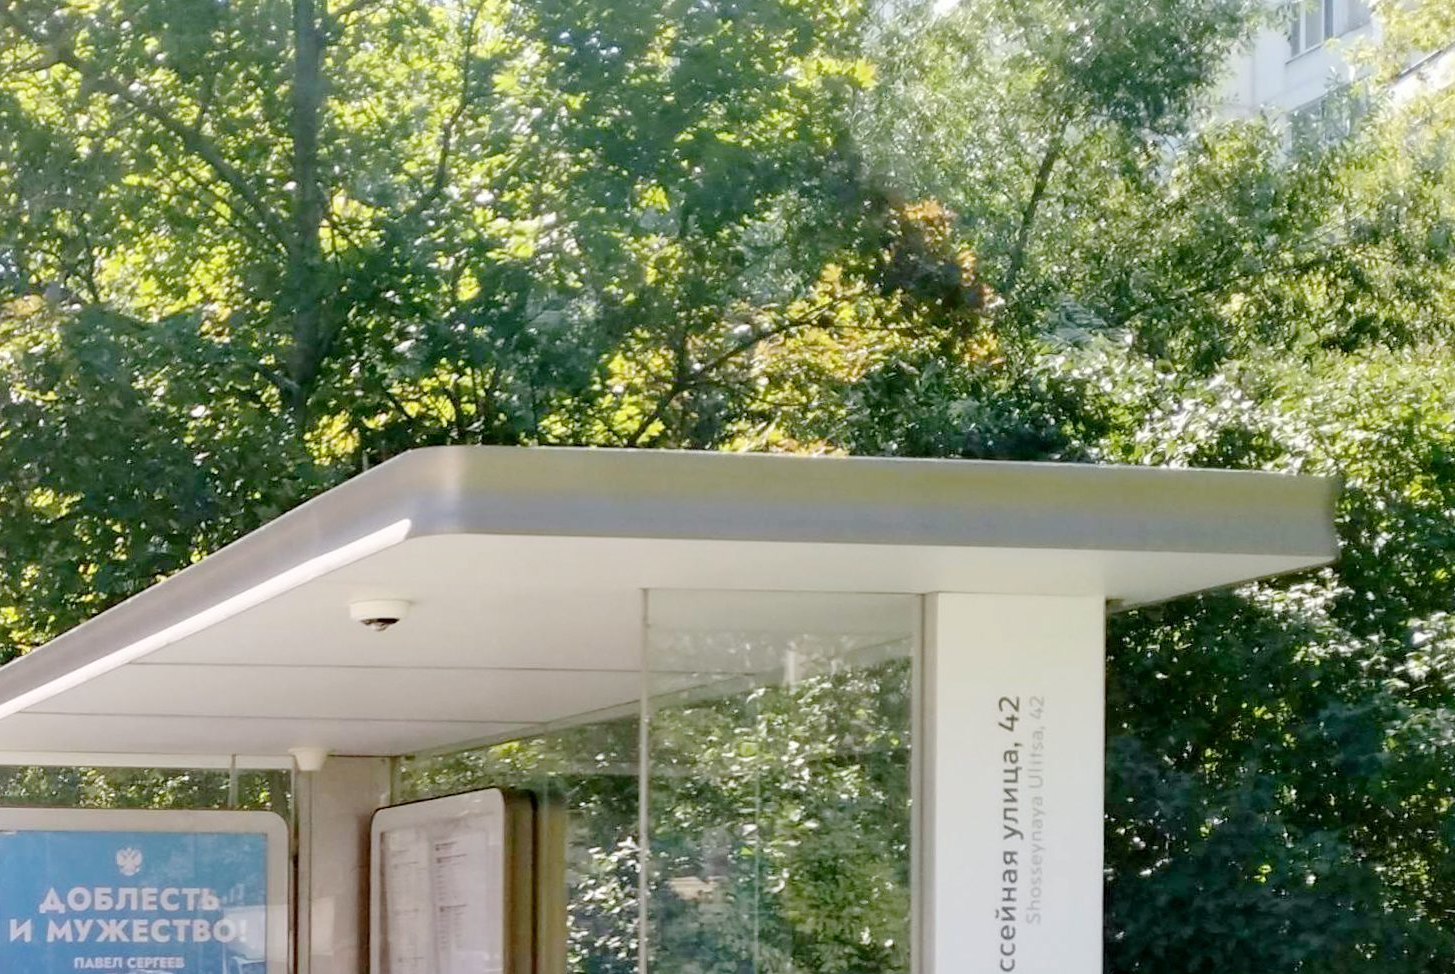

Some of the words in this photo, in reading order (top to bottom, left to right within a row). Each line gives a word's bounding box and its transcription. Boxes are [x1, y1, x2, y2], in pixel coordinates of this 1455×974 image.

[998, 695, 1020, 732] 42
[1029, 696, 1045, 720] 42
[1003, 741, 1024, 841] улица,
[1026, 796, 1046, 925] Shosseynaya
[39, 887, 221, 914] ДОБЛЕСТЬ
[9, 918, 33, 943] И
[47, 918, 248, 943] МУЖЕСТВО!
[73, 956, 123, 969] ПАВЕЛ
[127, 956, 186, 969] СЕРГЕЕВ
